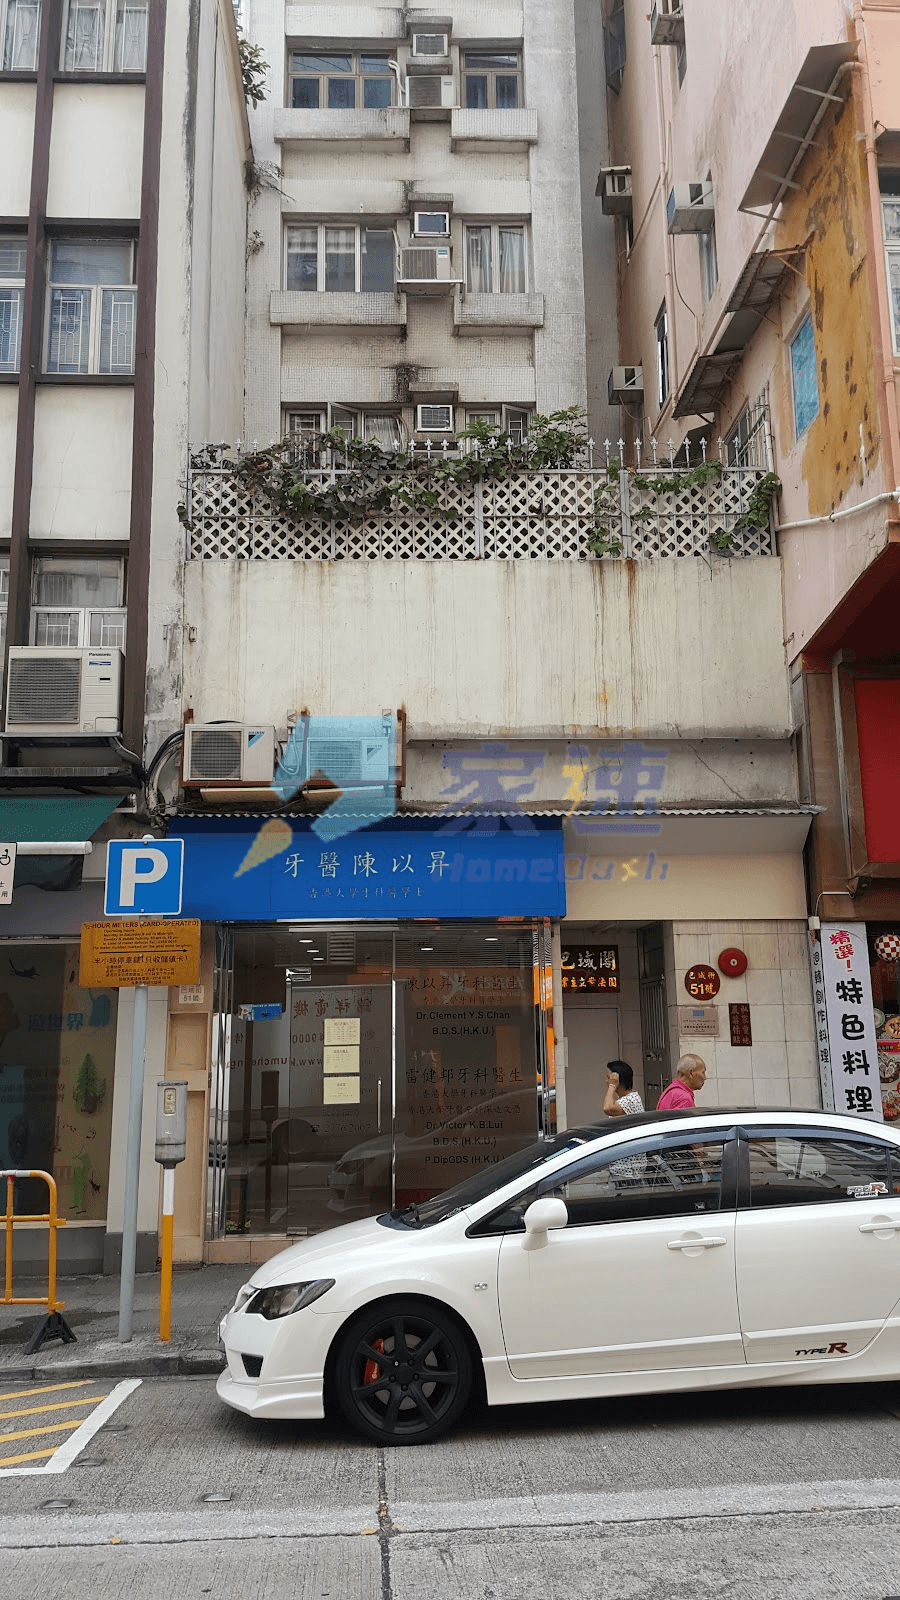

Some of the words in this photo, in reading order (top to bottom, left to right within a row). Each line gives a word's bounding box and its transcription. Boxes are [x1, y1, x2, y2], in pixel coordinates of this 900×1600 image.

[283, 850, 450, 879] 牙醫陳以昇
[118, 848, 169, 907] P
[112, 920, 138, 928] METERS
[690, 983, 716, 995] 51號
[416, 1012, 466, 1020] Dr.Clement
[469, 1012, 510, 1020] Y.S.Chan
[432, 1026, 494, 1036] B.D.S.(H.K.U.)
[836, 978, 874, 1112] 特色料理
[406, 1067, 524, 1084] 雷健邦牙科醫生
[470, 1121, 503, 1129] K.B.Lui
[795, 1348, 828, 1356] TYPE
[828, 1342, 850, 1354] R
